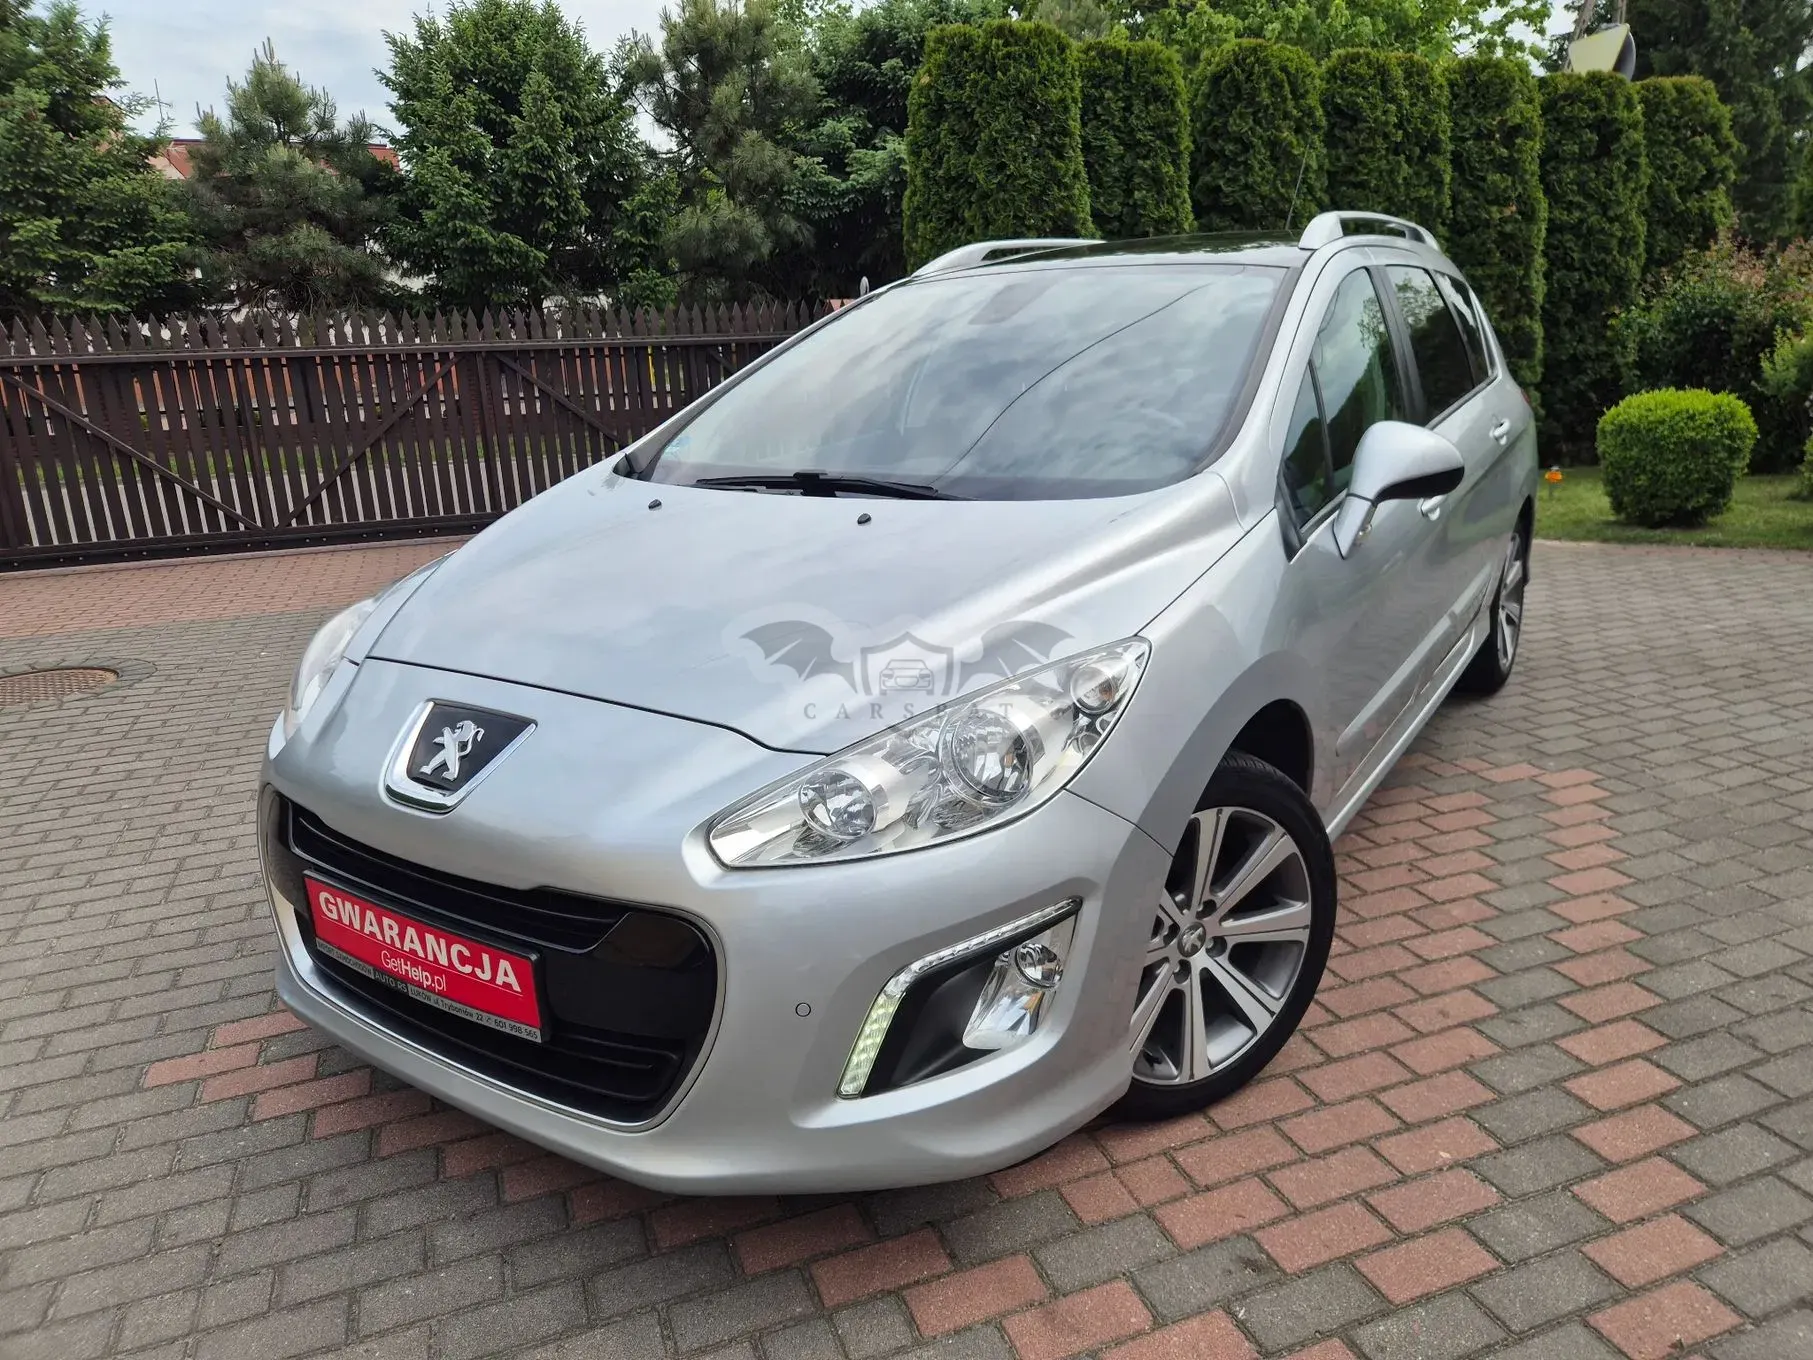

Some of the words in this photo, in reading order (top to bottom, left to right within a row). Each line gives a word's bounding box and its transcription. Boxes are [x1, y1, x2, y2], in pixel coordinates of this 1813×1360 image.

[318, 890, 523, 993] GWARANCJA
[375, 971, 396, 988] AUTO
[381, 950, 447, 993] GetHelp.pl
[475, 1012, 484, 1022] 22
[494, 1018, 507, 1031] 601
[508, 1022, 524, 1034] 998
[525, 1028, 539, 1040] 565
